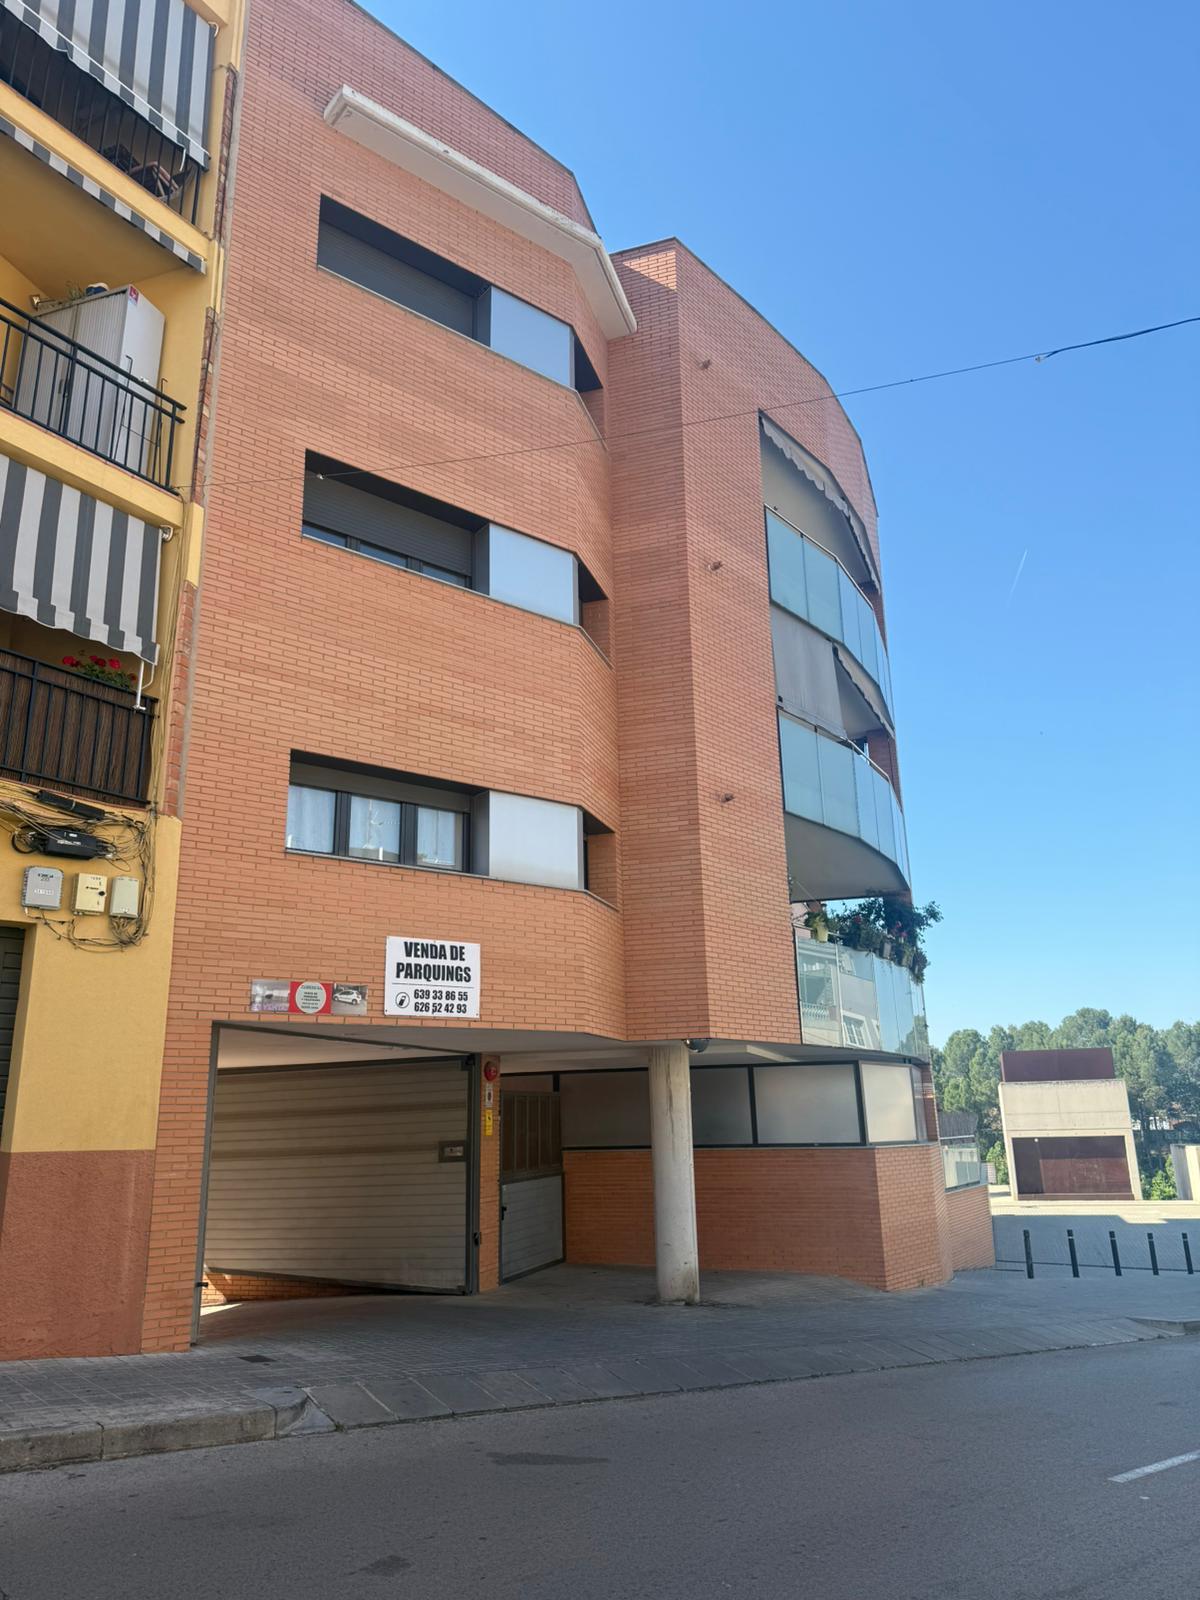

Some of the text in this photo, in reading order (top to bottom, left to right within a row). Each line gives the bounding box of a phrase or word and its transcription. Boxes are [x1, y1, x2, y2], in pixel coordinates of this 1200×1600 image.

[404, 941, 466, 961] VENDA DE
[395, 962, 472, 982] PARQUINGS
[414, 989, 468, 1001] 639 33 86 55
[414, 1002, 467, 1014] 626 52 42 93
